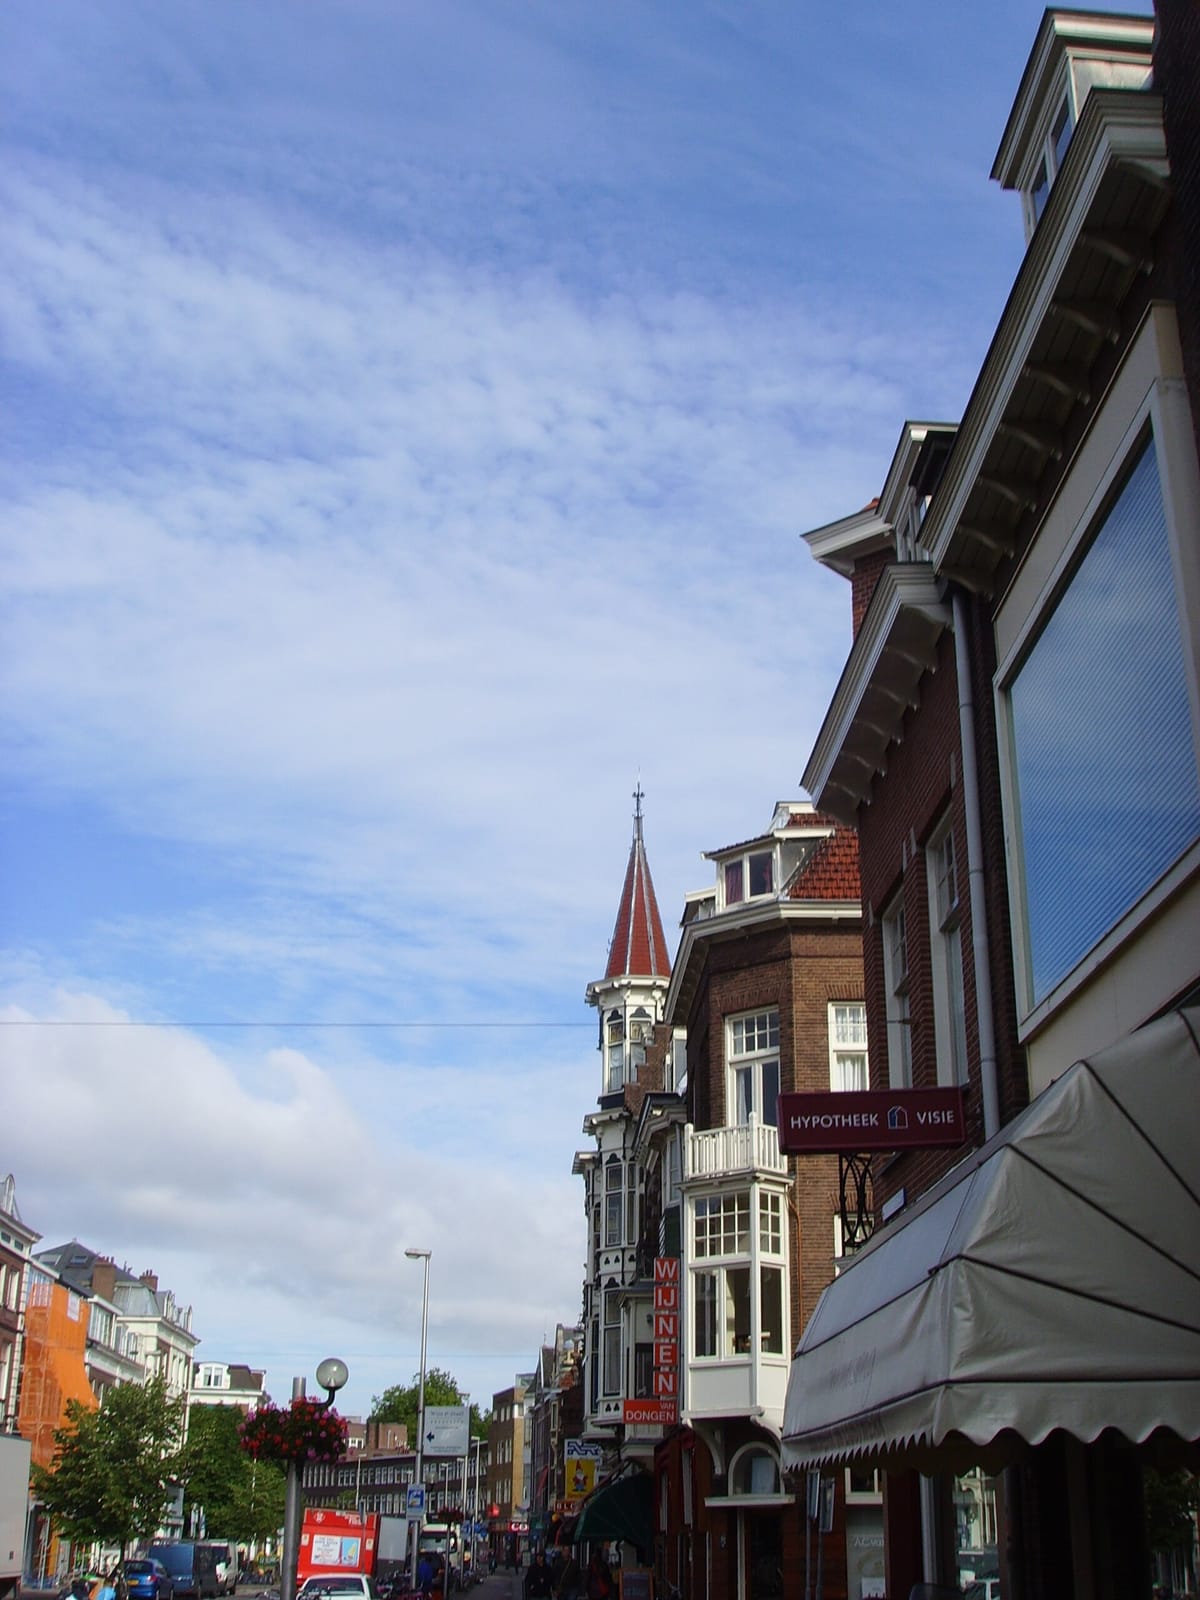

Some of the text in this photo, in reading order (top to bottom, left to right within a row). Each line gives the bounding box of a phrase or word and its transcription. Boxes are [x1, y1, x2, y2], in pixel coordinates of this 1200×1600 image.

[790, 1110, 955, 1130] HYPOTHEEK VISIE
[656, 1260, 677, 1393] WIJNEN
[659, 1402, 675, 1410] VAN
[625, 1410, 675, 1421] DONGEN
